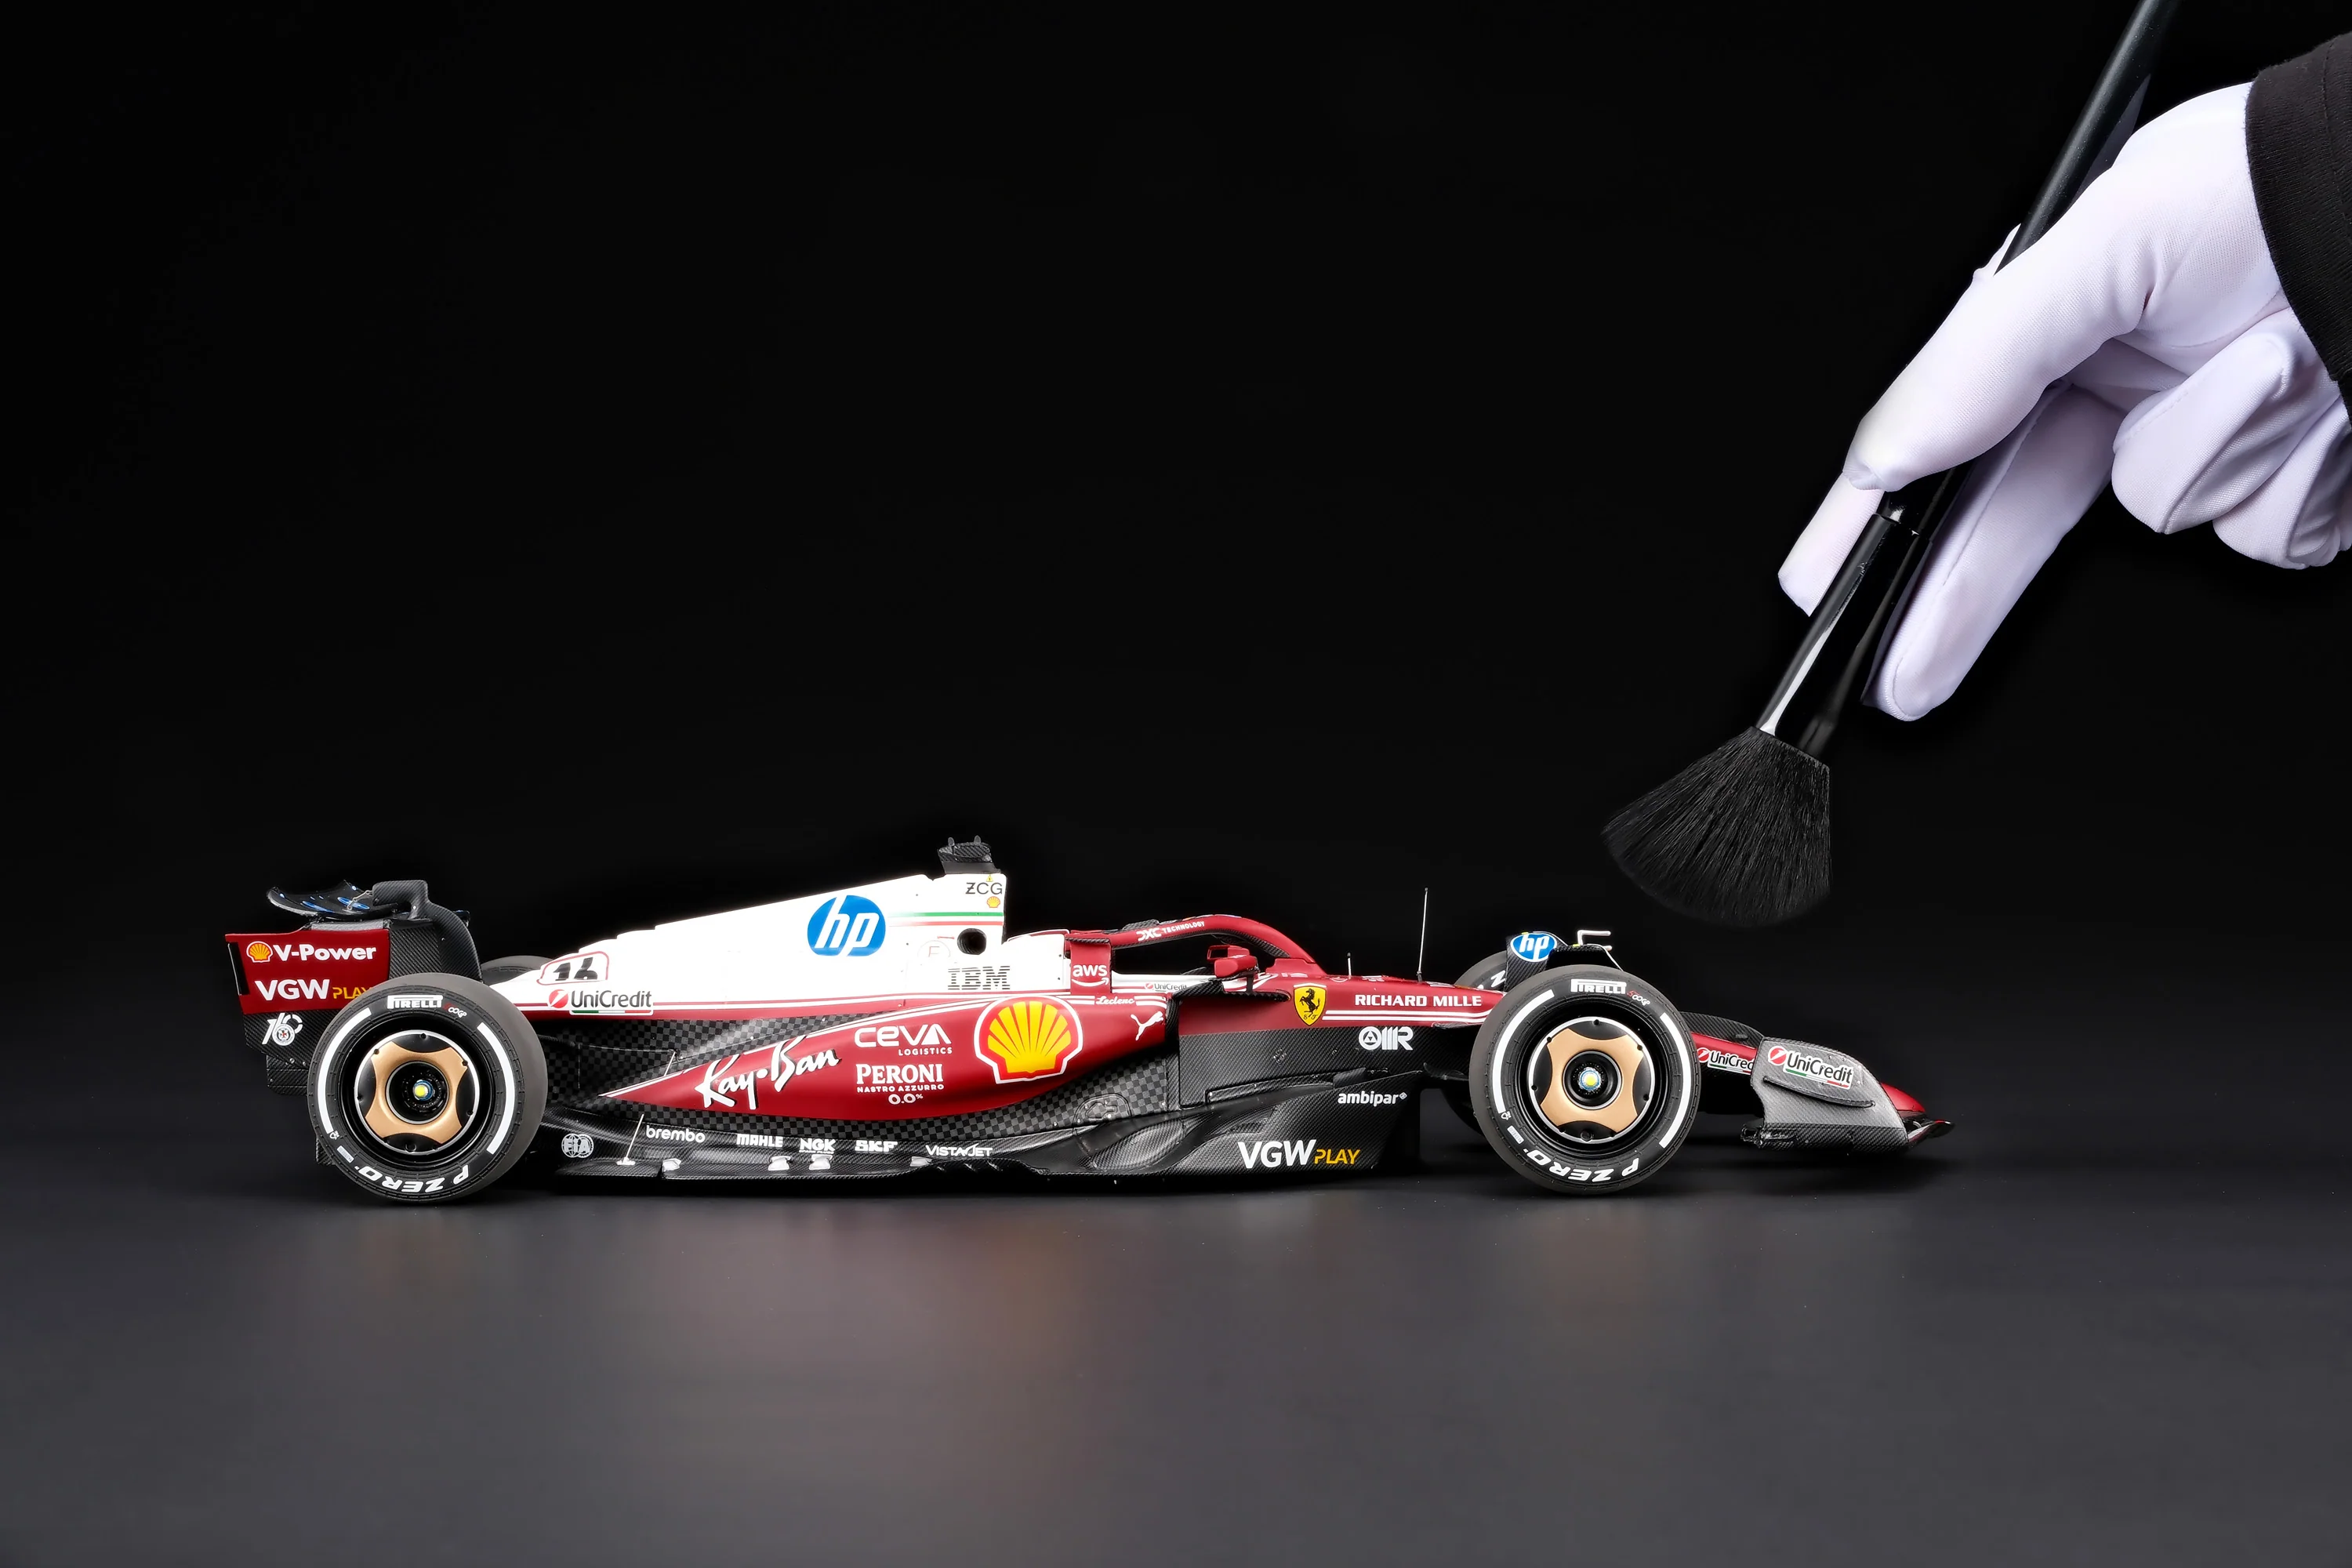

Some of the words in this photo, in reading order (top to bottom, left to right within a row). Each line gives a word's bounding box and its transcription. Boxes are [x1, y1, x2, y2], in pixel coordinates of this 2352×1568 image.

[814, 895, 880, 956] hp
[1162, 920, 1204, 934] TECHNOLOGY
[273, 944, 376, 961] V-Power
[1519, 934, 1550, 962] hp
[947, 966, 1011, 990] IBM
[1073, 964, 1107, 977] aws
[255, 979, 330, 1000] VGW
[1570, 978, 1627, 994] PIRELLI
[387, 995, 443, 1009] PIRELLI
[571, 990, 652, 1008] UniCredit
[1355, 994, 1427, 1007] RICHARD
[1433, 995, 1482, 1007] MILLE
[898, 1047, 953, 1056] LOGISTICS
[1710, 1051, 1754, 1070] UniCre
[855, 1064, 944, 1084] PERONI
[1787, 1051, 1853, 1084] UniCredit
[888, 1093, 924, 1105] 0.0%
[1338, 1091, 1399, 1107] ambipar
[646, 1125, 706, 1143] brembo
[736, 1134, 783, 1148] MAHLE
[800, 1138, 836, 1151] NGK
[855, 1140, 898, 1152] SKF
[1237, 1139, 1317, 1168] VGW
[1314, 1149, 1360, 1164] PLAY
[452, 1164, 469, 1185] P
[1526, 1149, 1614, 1182] ZERO
[1621, 1158, 1639, 1176] P
[358, 1166, 445, 1192] ZERO
